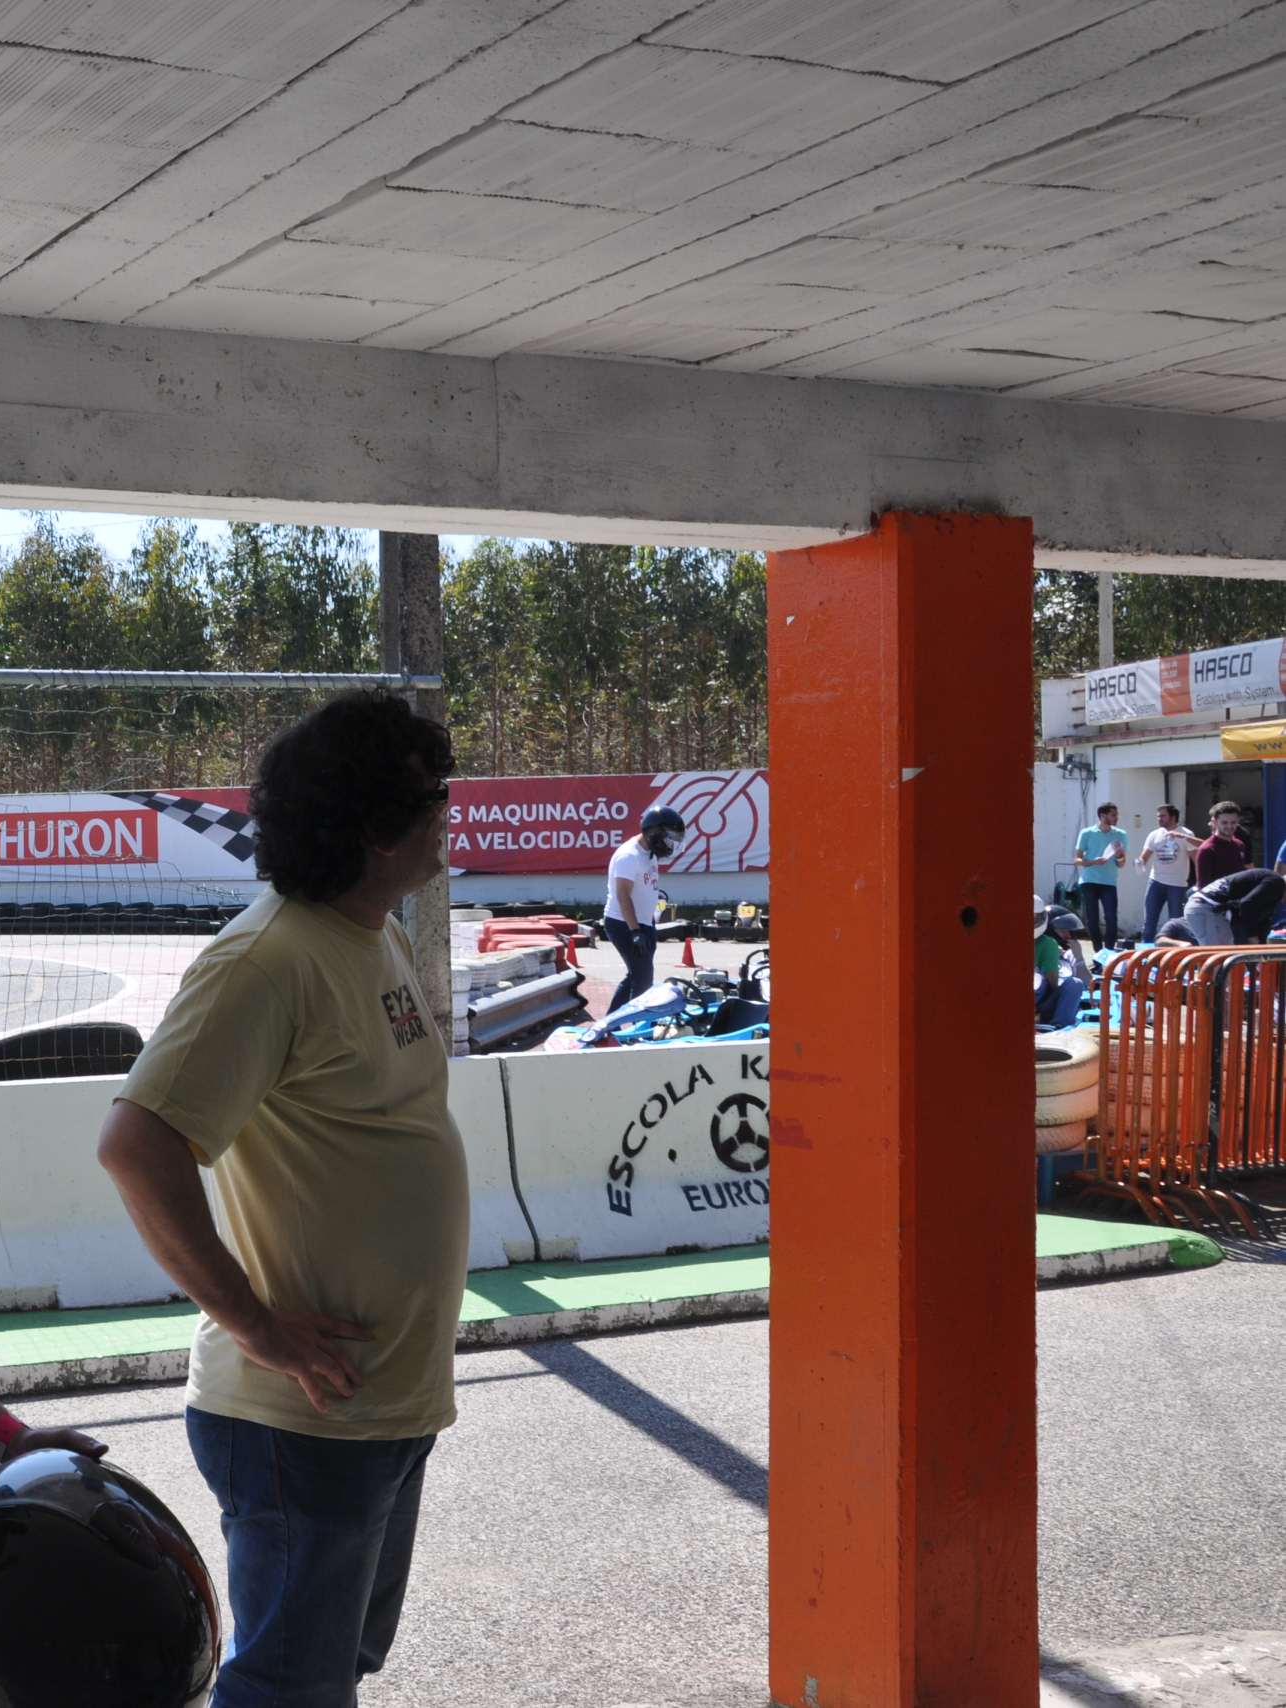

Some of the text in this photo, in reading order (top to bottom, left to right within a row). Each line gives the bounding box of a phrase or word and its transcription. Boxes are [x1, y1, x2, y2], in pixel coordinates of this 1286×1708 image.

[1194, 652, 1253, 684] HASCO
[1089, 672, 1137, 700] HASCO
[1244, 686, 1275, 701] System
[447, 797, 629, 826] S MAQUINAÇÃO
[0, 817, 144, 860] HURON
[476, 830, 623, 850] VELOCIDADE
[392, 1018, 429, 1050] WEAR
[607, 1063, 714, 1217] ESCOLA
[681, 1178, 770, 1212] EURO
